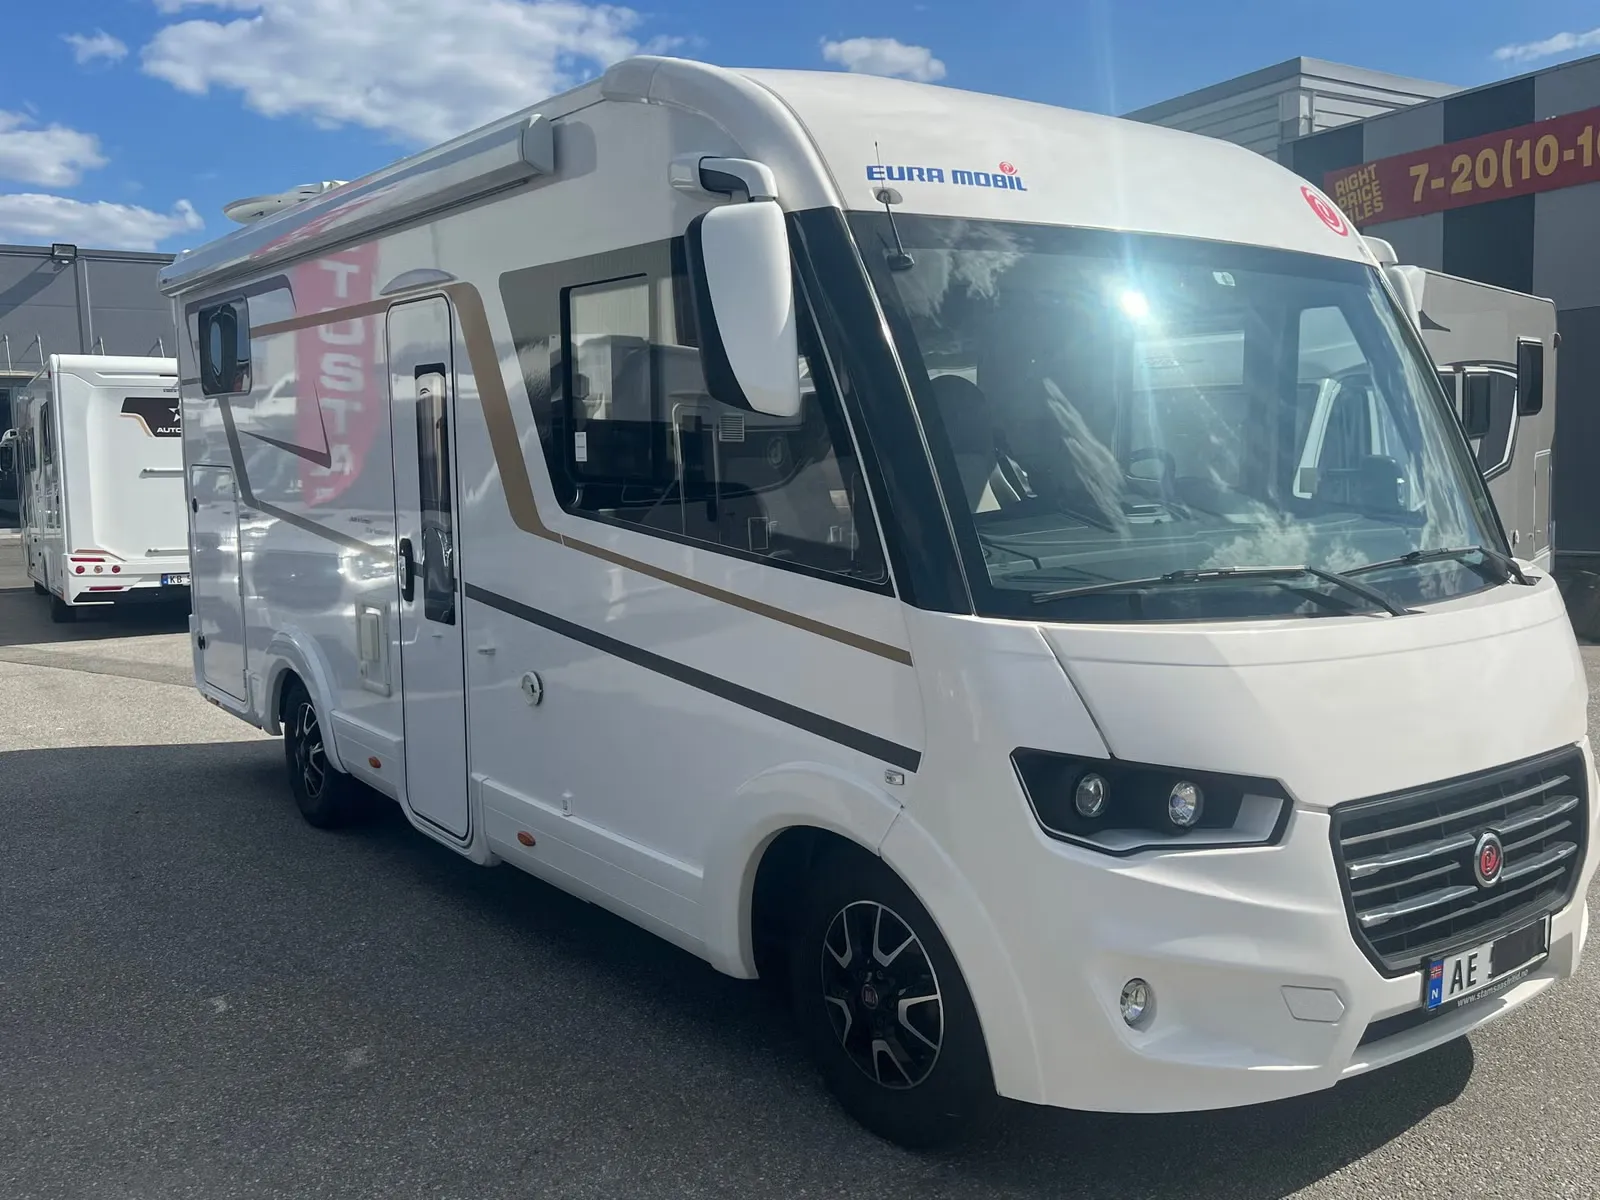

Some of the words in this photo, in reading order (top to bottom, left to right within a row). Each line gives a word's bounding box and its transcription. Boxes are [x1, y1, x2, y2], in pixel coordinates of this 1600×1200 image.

[866, 165, 945, 183] EURA
[951, 169, 1028, 191] MOBIL
[1408, 125, 1600, 203] 7-20(10-1
[1334, 163, 1377, 197] RIGHT
[1338, 180, 1382, 210] PRICE
[169, 575, 182, 584] KB
[1450, 952, 1478, 995] AE
[1431, 988, 1439, 1000] N
